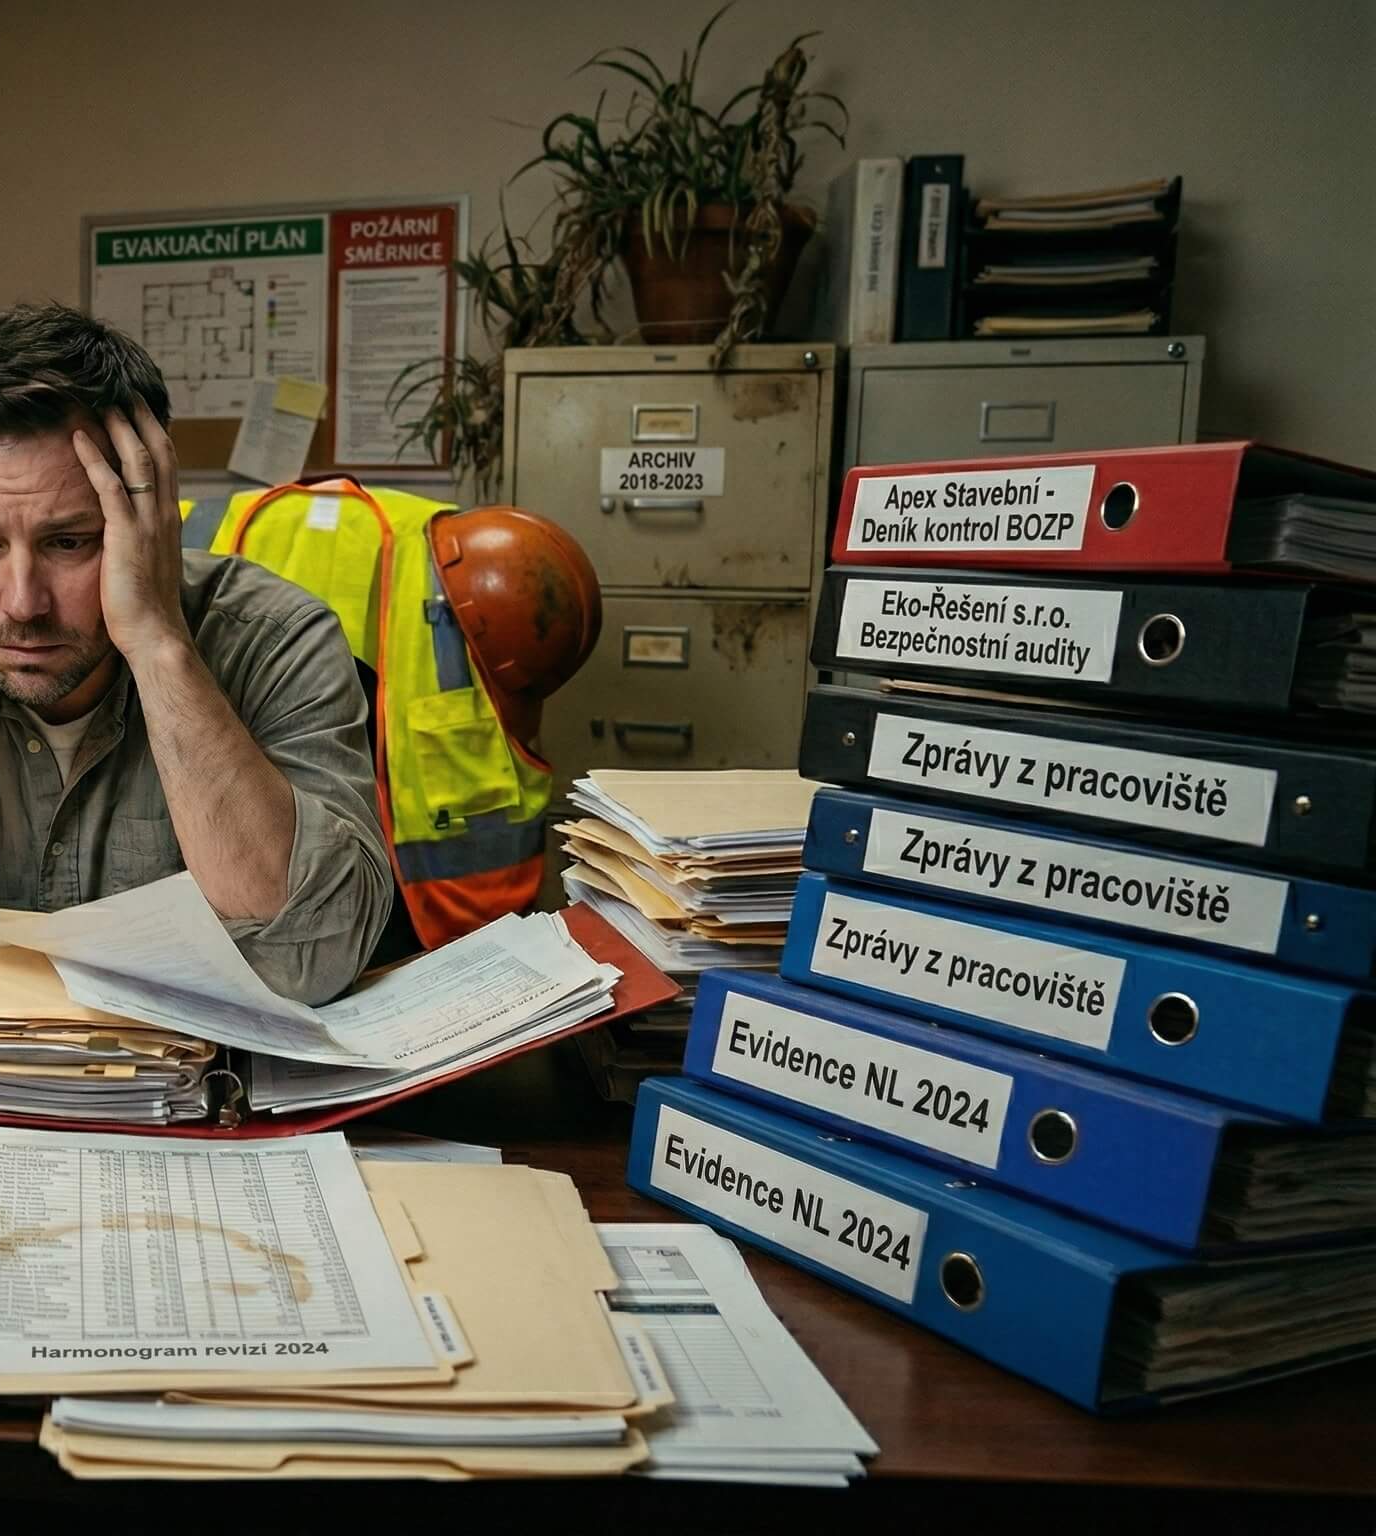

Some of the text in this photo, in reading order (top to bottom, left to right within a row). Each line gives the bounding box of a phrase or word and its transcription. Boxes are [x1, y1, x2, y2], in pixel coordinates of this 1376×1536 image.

[112, 225, 307, 259] EVAKUAČNÍ PLÁN
[350, 213, 439, 240] POŽÁRNÍ
[344, 240, 443, 264] SMĚRNICE
[628, 452, 695, 468] ARCHIV
[619, 474, 703, 490] 2018-2023
[884, 484, 937, 515] Apex
[943, 477, 1042, 508] Stavební
[861, 512, 1074, 543] Deník kontrol BOZP
[881, 586, 1071, 628] Eko-Řešení s.r.o.
[860, 622, 1091, 674] Bezpečnostní audity
[902, 731, 1227, 817] Zprávy z pracoviště
[900, 827, 1230, 924] Zprávy z pracoviště
[826, 918, 1106, 1016] Zprávy z pracoviště
[729, 1020, 990, 1134] Evidence NL 2024
[664, 1133, 912, 1272] Evidence NL 2024
[31, 1344, 197, 1360] Harmonogram
[274, 1341, 330, 1355] 2024
